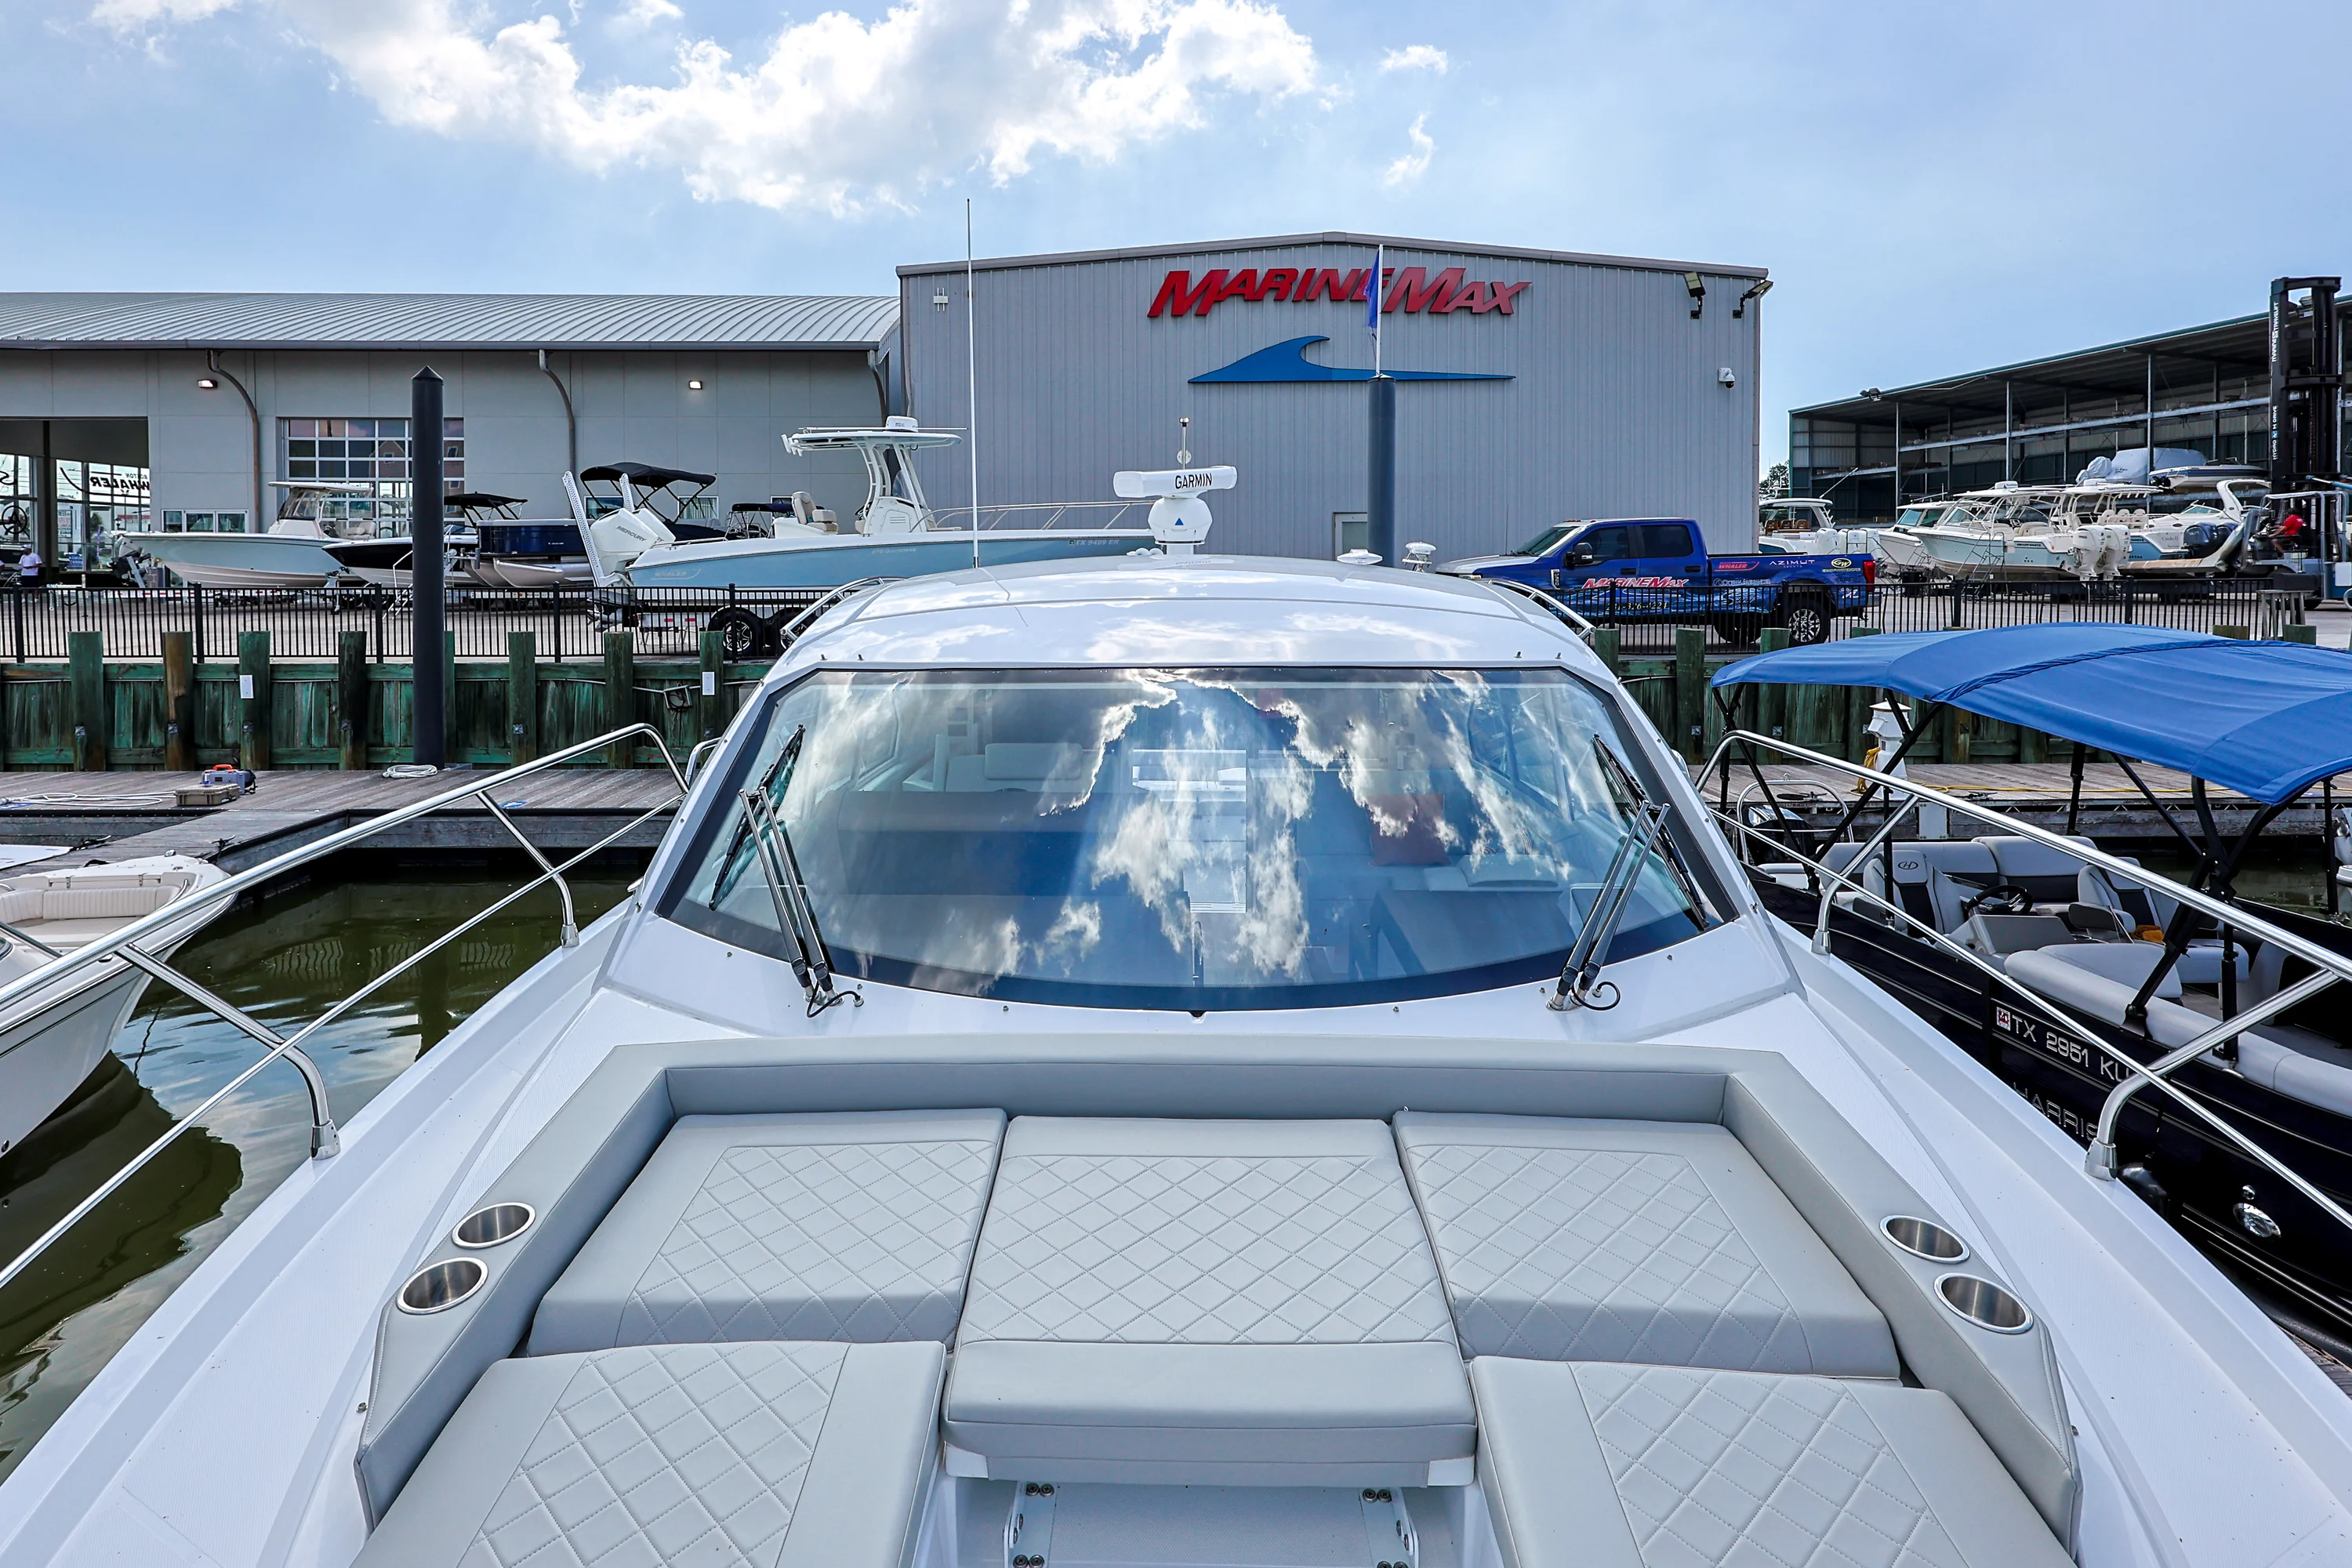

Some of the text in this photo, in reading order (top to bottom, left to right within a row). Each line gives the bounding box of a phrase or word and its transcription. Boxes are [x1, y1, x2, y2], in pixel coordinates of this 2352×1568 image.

[1146, 267, 1532, 318] MARINEMAX
[1175, 473, 1212, 489] GARMIN
[616, 525, 647, 542] MERCURY
[2012, 1014, 2036, 1043] TX
[2046, 1032, 2089, 1067] 2951
